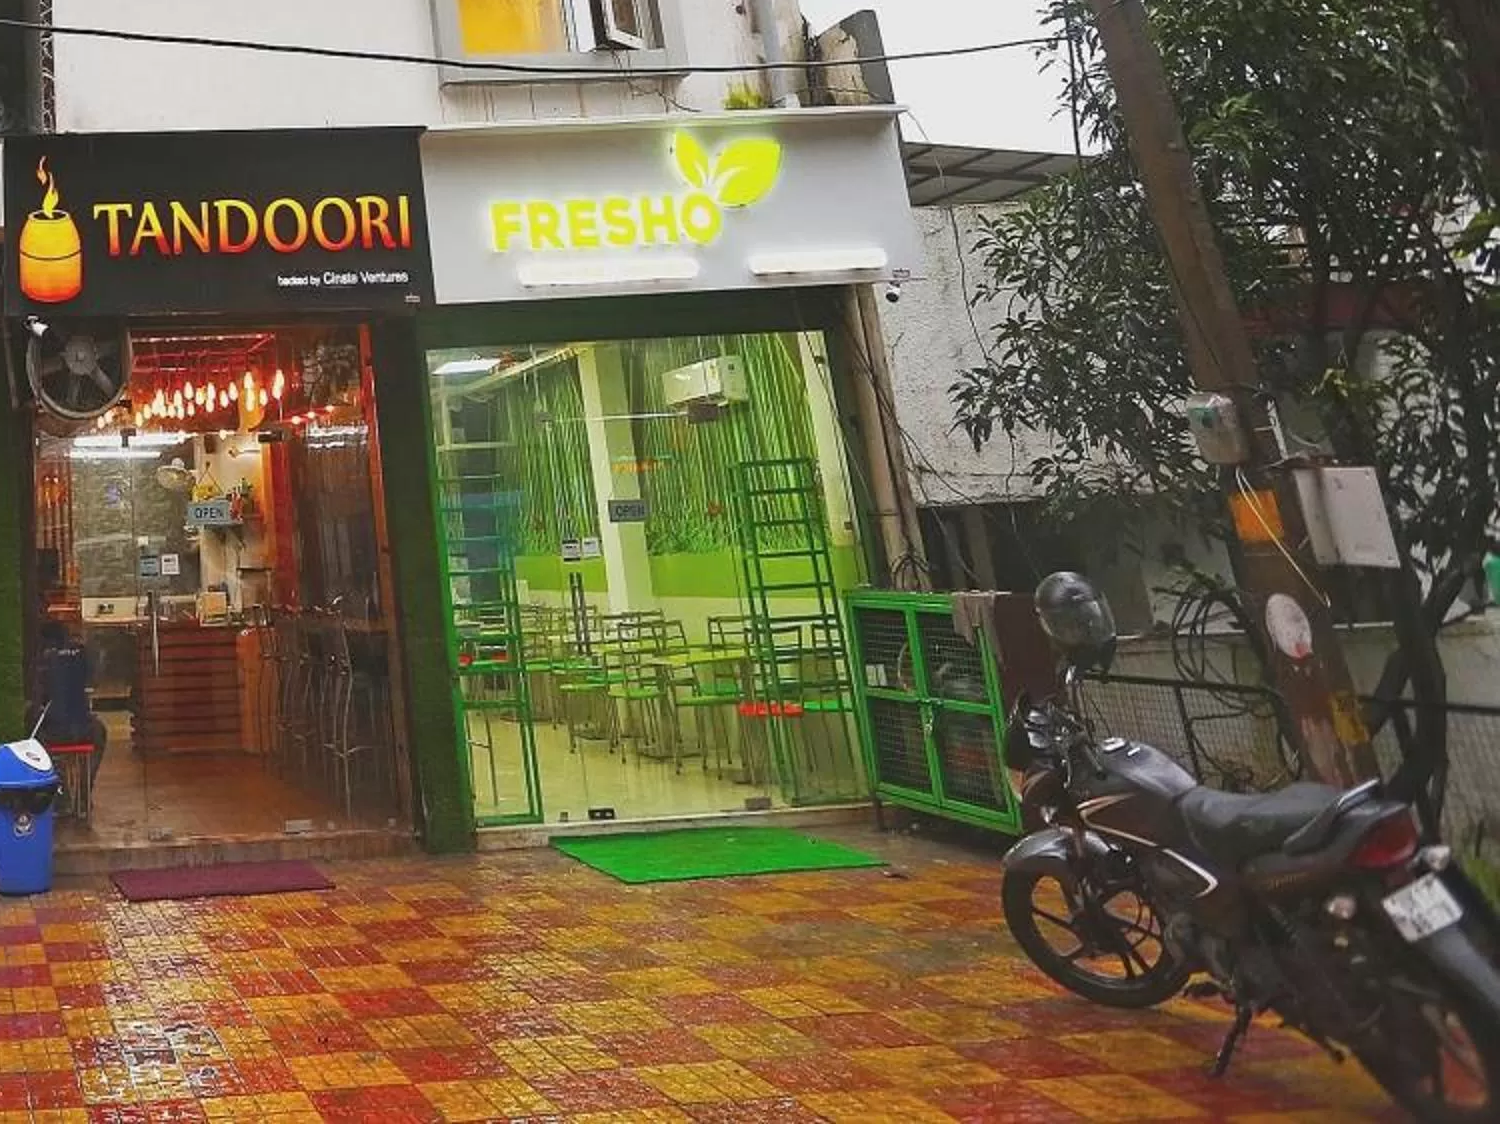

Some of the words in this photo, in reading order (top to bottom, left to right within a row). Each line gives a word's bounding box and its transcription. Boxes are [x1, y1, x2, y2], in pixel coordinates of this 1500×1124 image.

[93, 195, 412, 256] TANDOORI
[489, 191, 722, 252] FRESHO
[310, 275, 321, 287] by
[360, 270, 409, 284] Ventures
[195, 506, 226, 519] OPEN
[615, 504, 646, 518] OPEN
